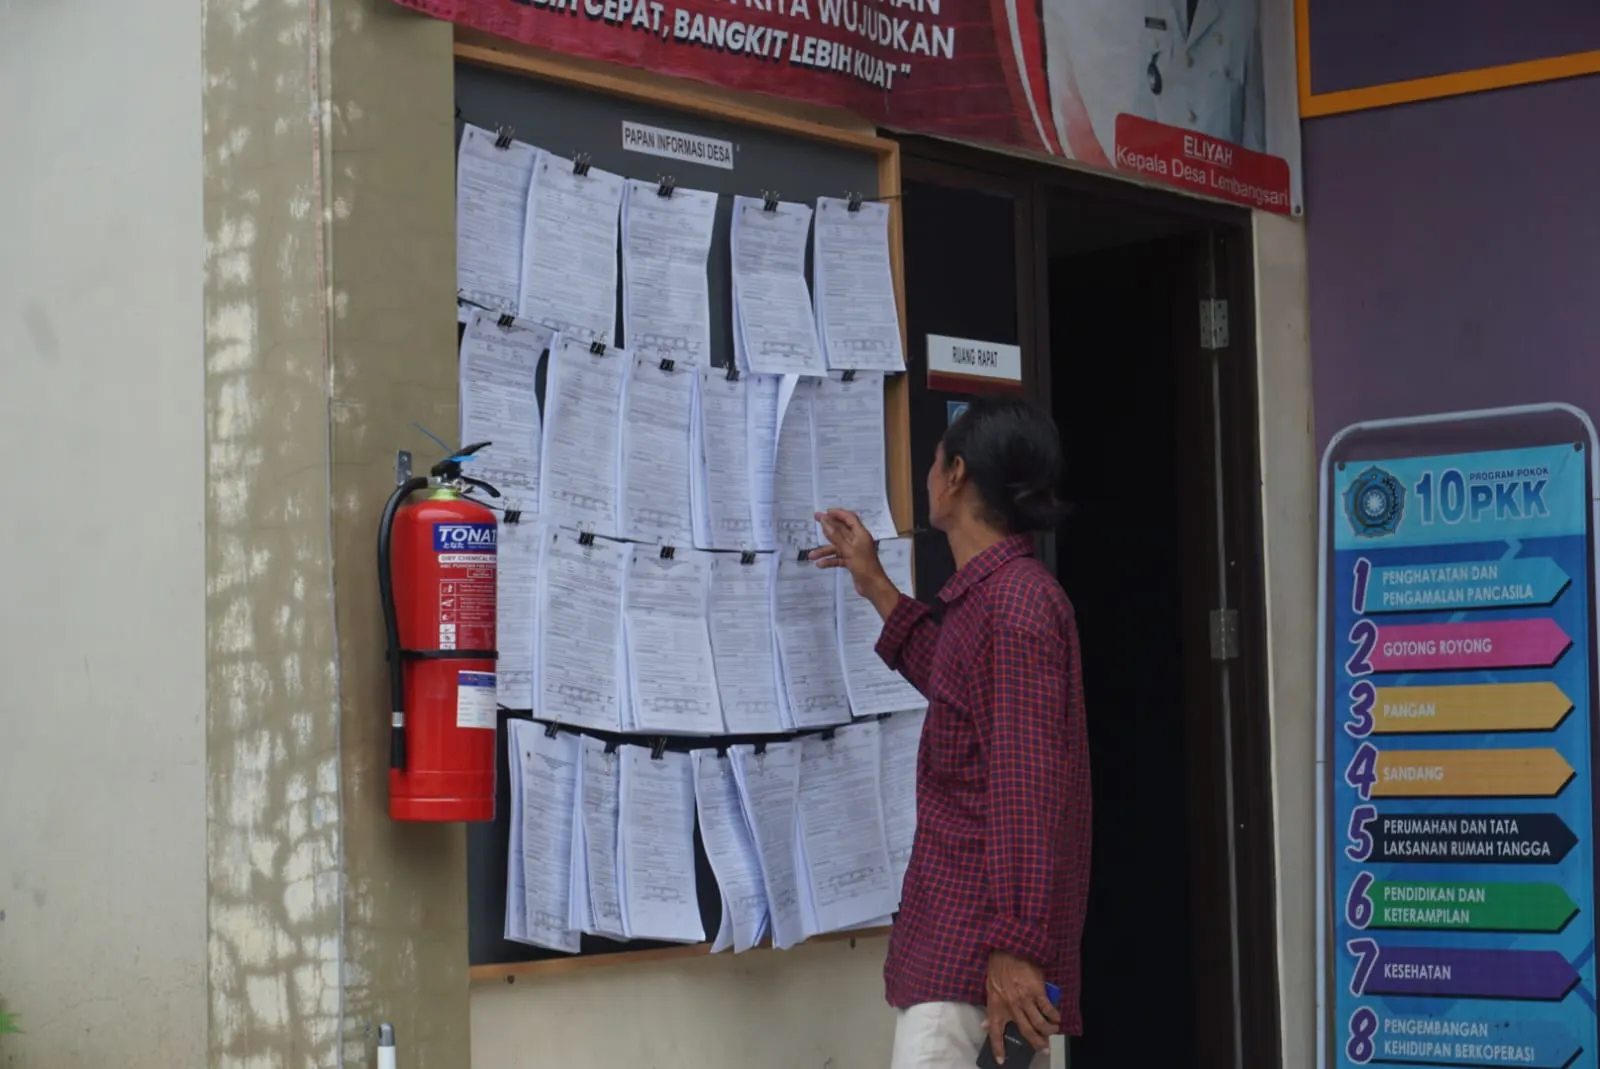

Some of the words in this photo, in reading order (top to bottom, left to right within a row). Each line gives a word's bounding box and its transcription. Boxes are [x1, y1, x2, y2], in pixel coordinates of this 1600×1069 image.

[673, 8, 788, 58] BANGKIT
[789, 34, 852, 73] LEBIH
[817, 0, 955, 59] WUJUDKAN
[624, 127, 655, 148] PAPAN
[656, 134, 705, 158] INFORMASI
[707, 143, 731, 163] DESA
[1184, 135, 1232, 165] ELIYAH
[1116, 145, 1167, 174] Kepala
[1172, 159, 1205, 185] Desa
[1211, 169, 1289, 206] Lembangsari
[952, 346, 975, 365] RUANG
[977, 350, 998, 368] RAPAT
[1469, 470, 1514, 481] PROGRAM
[1517, 467, 1549, 477] POKOK
[1415, 468, 1466, 525] 10
[1469, 479, 1550, 522] PKK
[1352, 556, 1371, 614] 1
[1382, 566, 1468, 586] PENGHAYATAN
[1472, 565, 1497, 580] DAN
[1383, 588, 1464, 606] PENGAMALAN
[1467, 583, 1534, 602] PANCASILA
[1345, 619, 1378, 677] 2
[1383, 639, 1436, 656] GOTONG
[1439, 637, 1492, 654] ROYONG
[1344, 679, 1377, 739] 3
[1383, 702, 1436, 718] PANGAN
[1344, 741, 1378, 801] 4
[1383, 765, 1444, 781] SANDANG
[1344, 804, 1378, 862] 5
[1383, 819, 1457, 834] PERUMAHAN
[1460, 819, 1487, 834] DAN
[1489, 819, 1518, 834] TATA
[1383, 840, 1447, 856] LAKSANAN
[1451, 840, 1494, 856] RUMAH
[1496, 840, 1550, 856] TANGGA
[1345, 871, 1375, 930] 6
[1383, 886, 1455, 902] PENDIDIKAN
[1458, 887, 1485, 903] DAN
[1383, 908, 1469, 924] KETERAMPILAN
[1346, 938, 1379, 997] 7
[1383, 963, 1451, 980] KESEHATAN
[1345, 1005, 1379, 1064] 8
[1383, 1018, 1488, 1037] PENGEMBANGAN
[1383, 1040, 1451, 1058] KEHIDUPAN
[1455, 1042, 1534, 1062] BERKOPERASI
